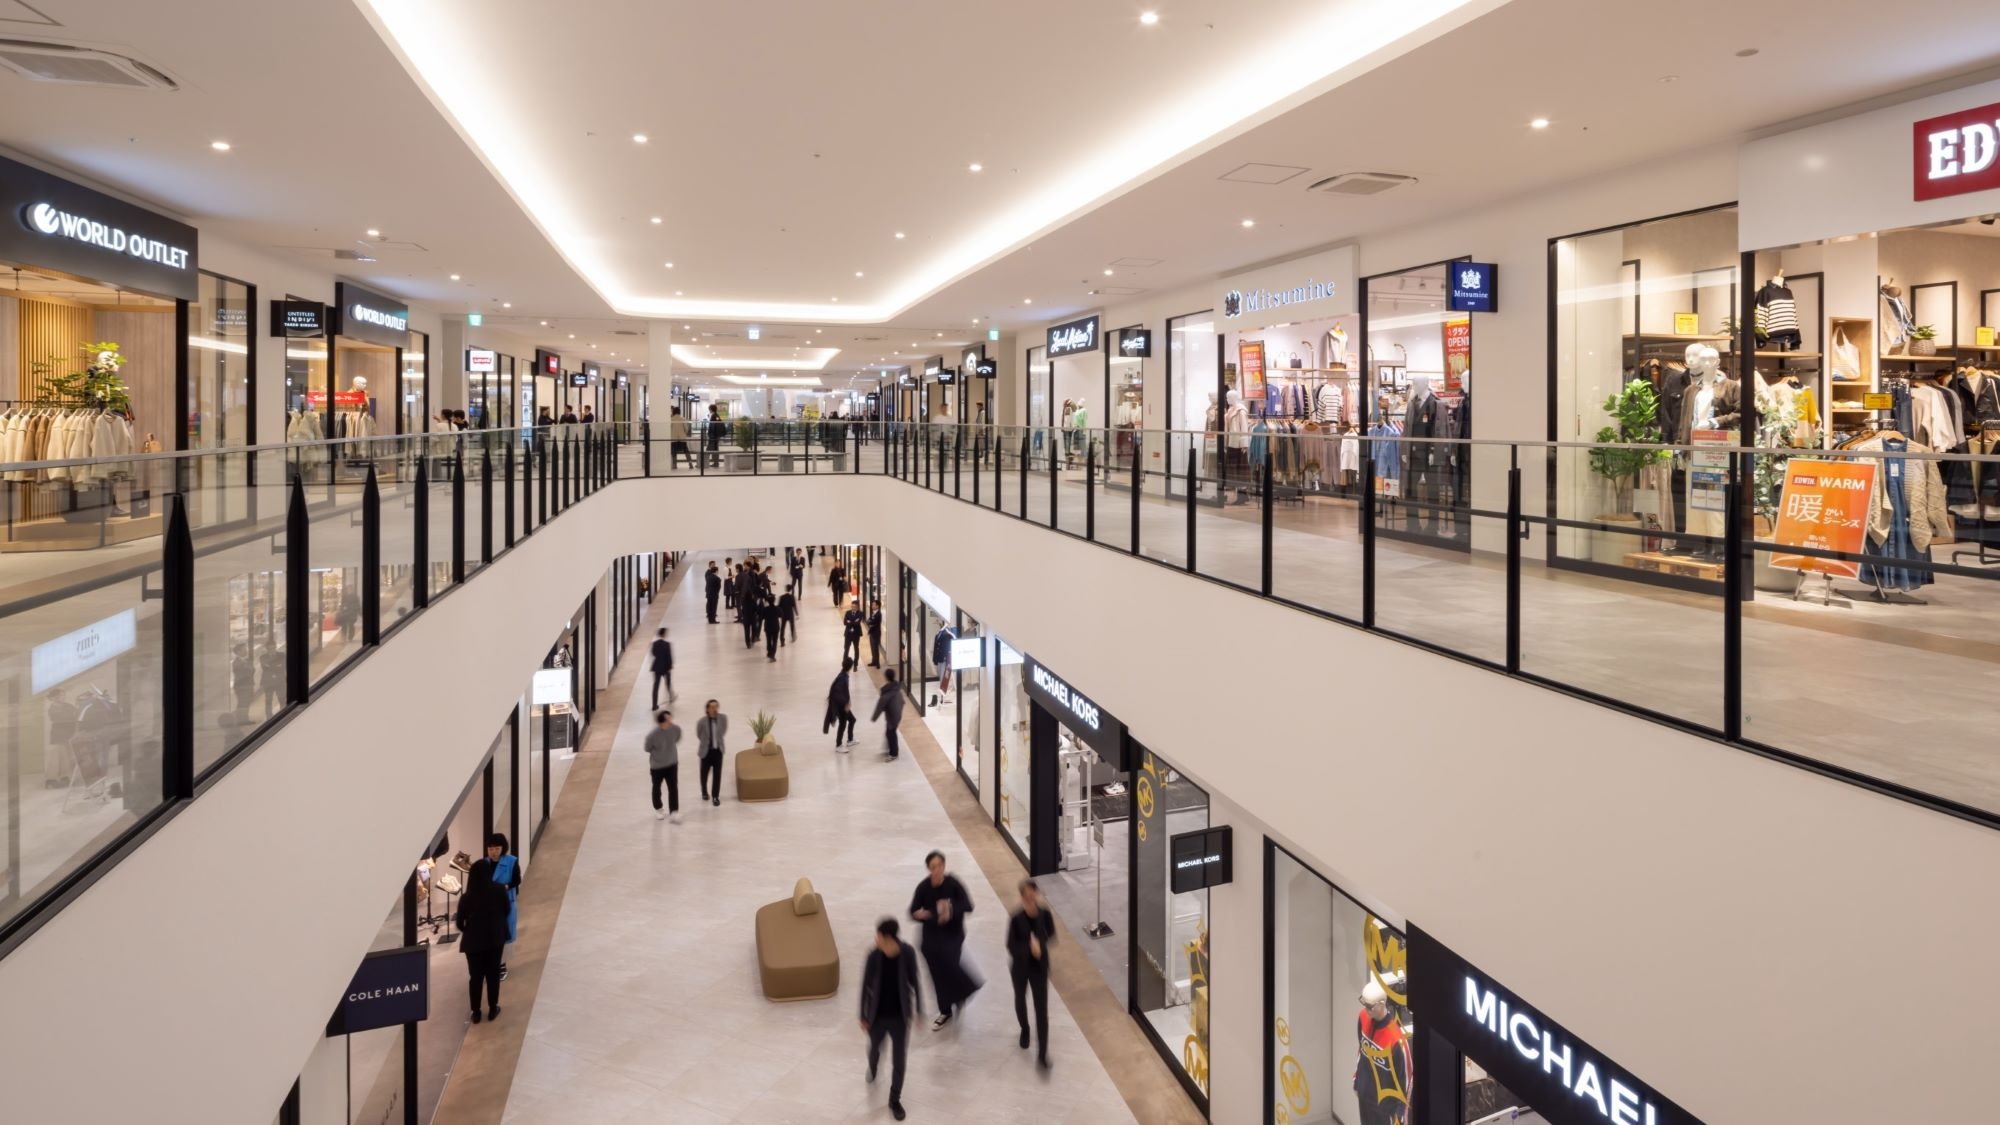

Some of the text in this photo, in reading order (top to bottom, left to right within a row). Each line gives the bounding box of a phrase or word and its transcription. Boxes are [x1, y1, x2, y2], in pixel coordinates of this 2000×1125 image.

[1928, 119, 2000, 179] ED
[59, 211, 188, 269] WORLD OUTLET
[1246, 278, 1336, 312] Mitsumine
[1454, 290, 1488, 298] Mitsumine
[363, 307, 407, 331] WORLD OUTLET
[1819, 476, 1865, 490] WARM
[1786, 493, 1844, 524] 暖 かい
[1822, 516, 1861, 529] ジーンズ
[1033, 664, 1099, 730] MICHAEL KORS
[1178, 854, 1220, 869] MICHAEL KORS
[349, 983, 419, 1002] COLE HAAN
